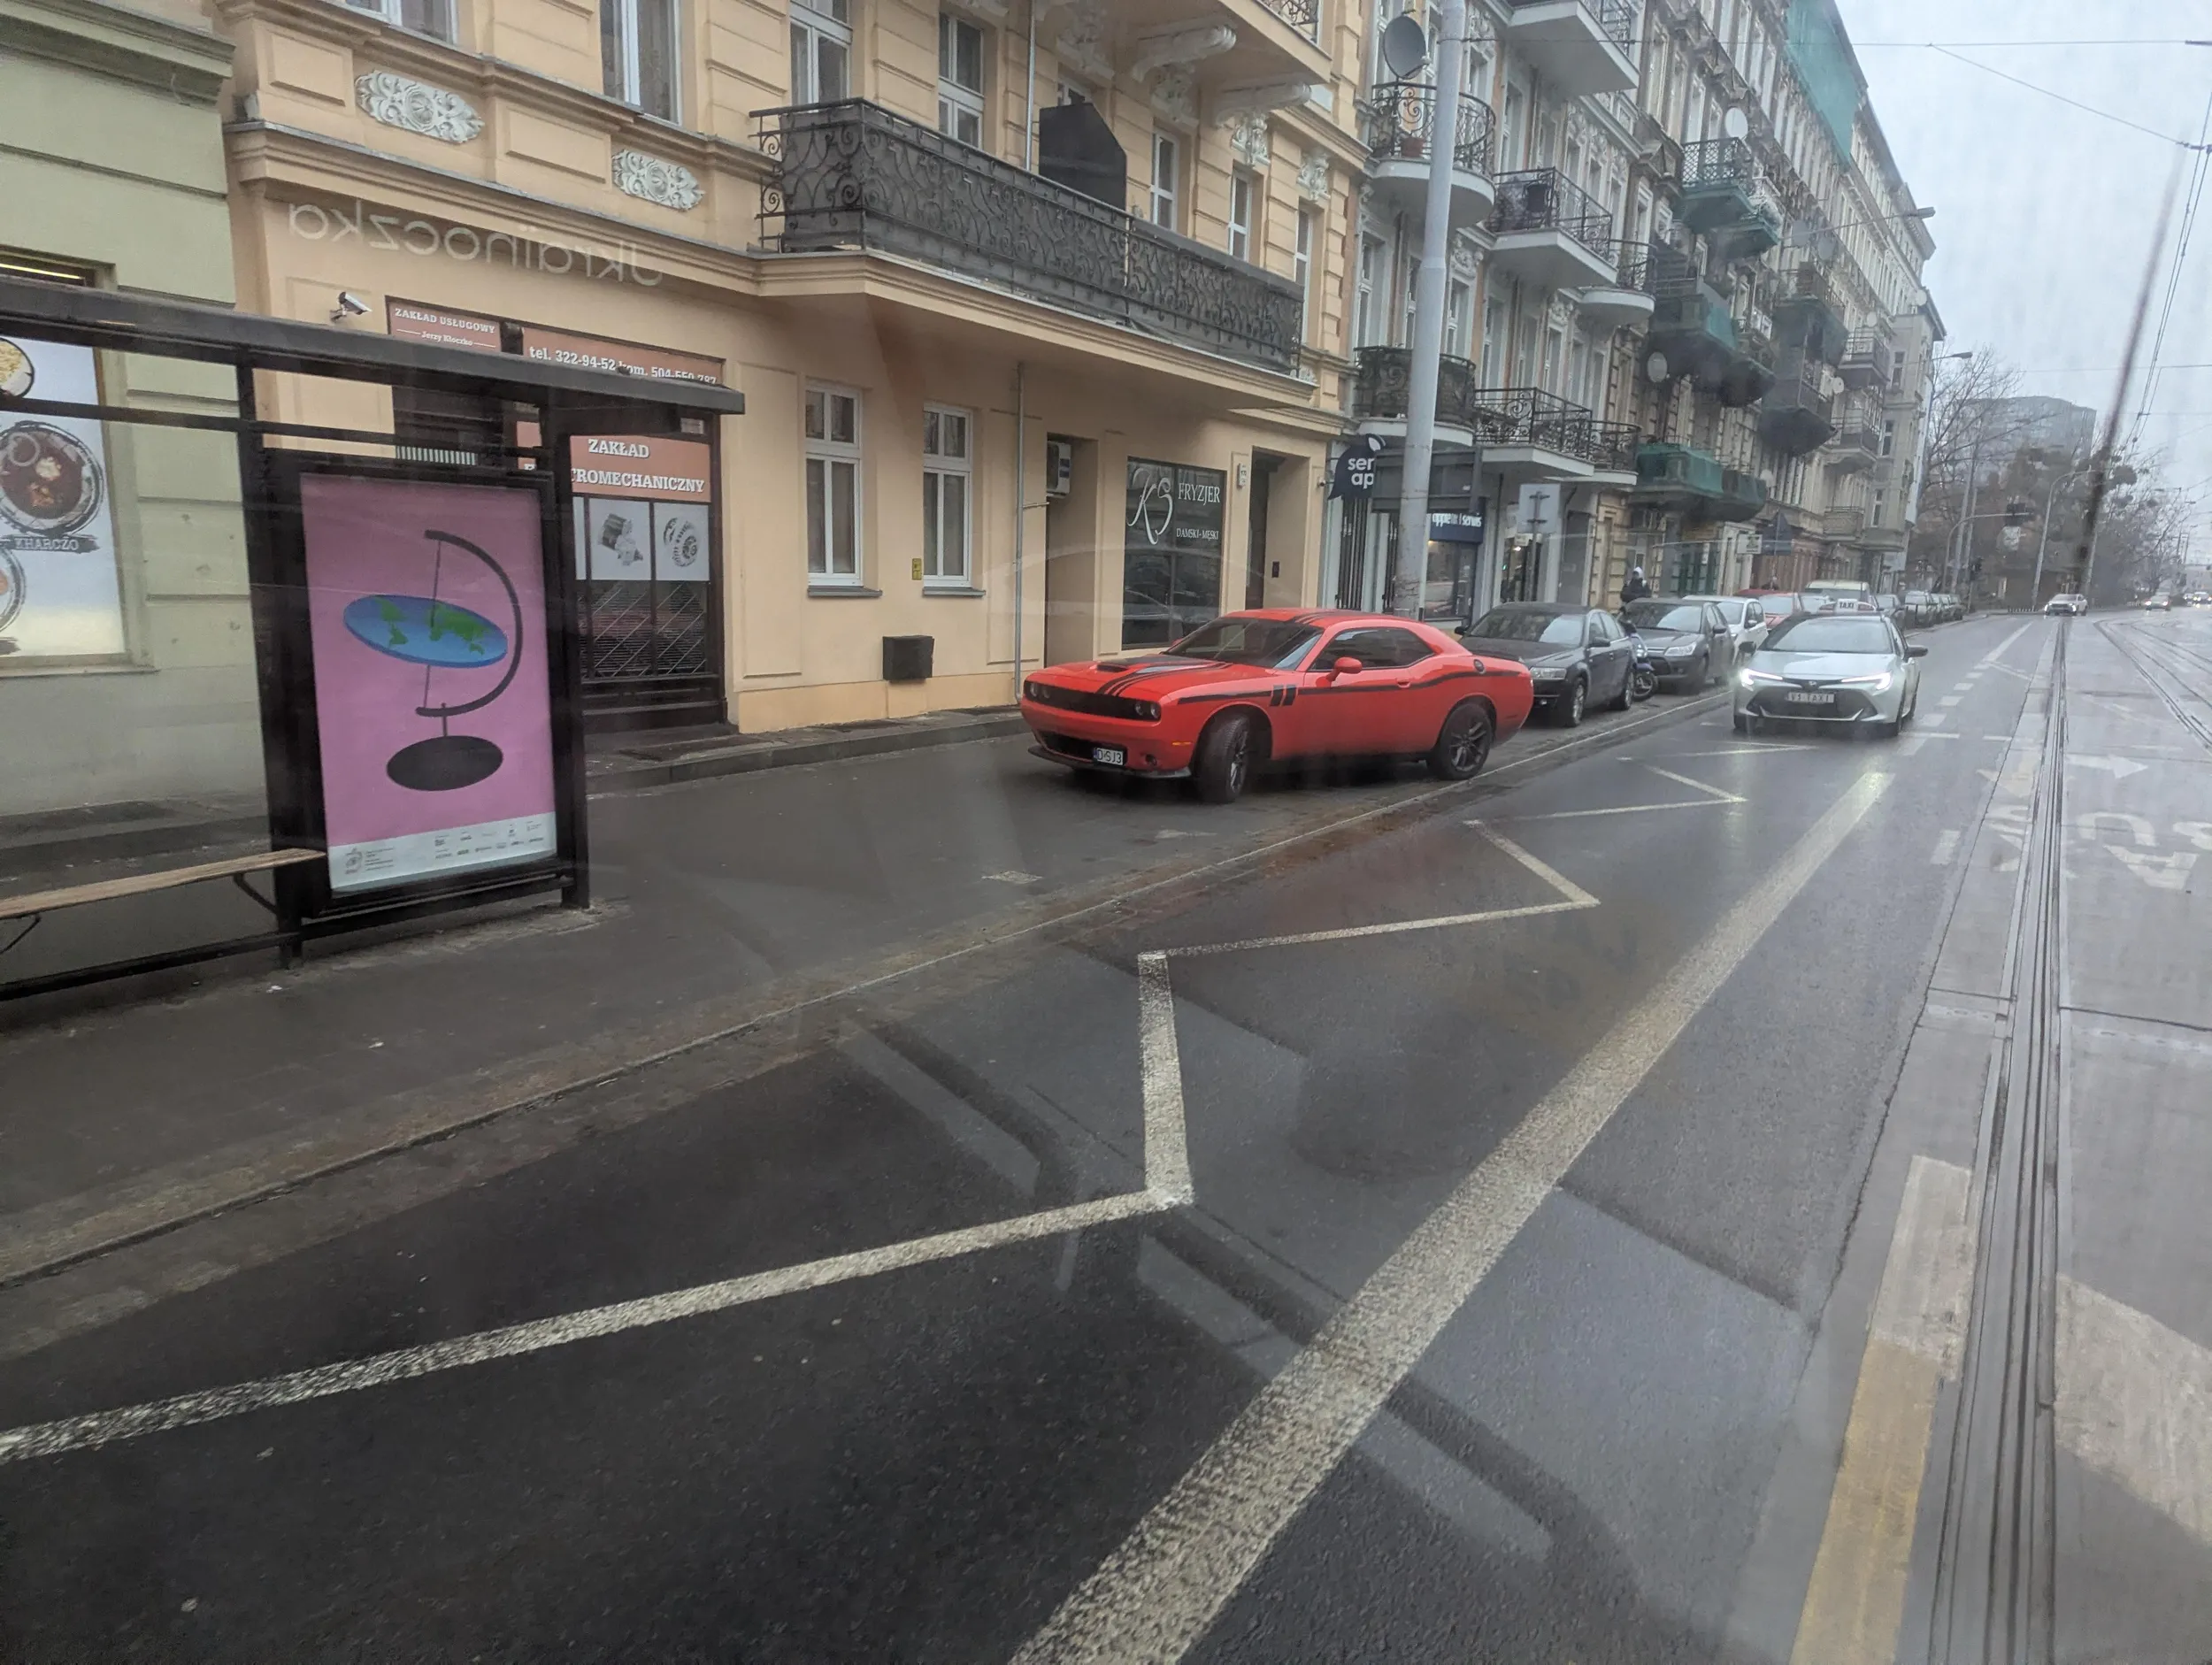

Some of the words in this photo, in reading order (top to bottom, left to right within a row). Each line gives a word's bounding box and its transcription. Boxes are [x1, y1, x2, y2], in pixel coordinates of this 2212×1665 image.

[395, 308, 437, 323] ZAKŁAD
[440, 316, 495, 334] USŁUGOWY
[421, 331, 442, 342] Jerzy
[529, 346, 551, 361] tel.
[555, 349, 616, 371] 322-94-52
[588, 438, 650, 458] ZAKŁAD
[1178, 482, 1220, 506] FRYZJER
